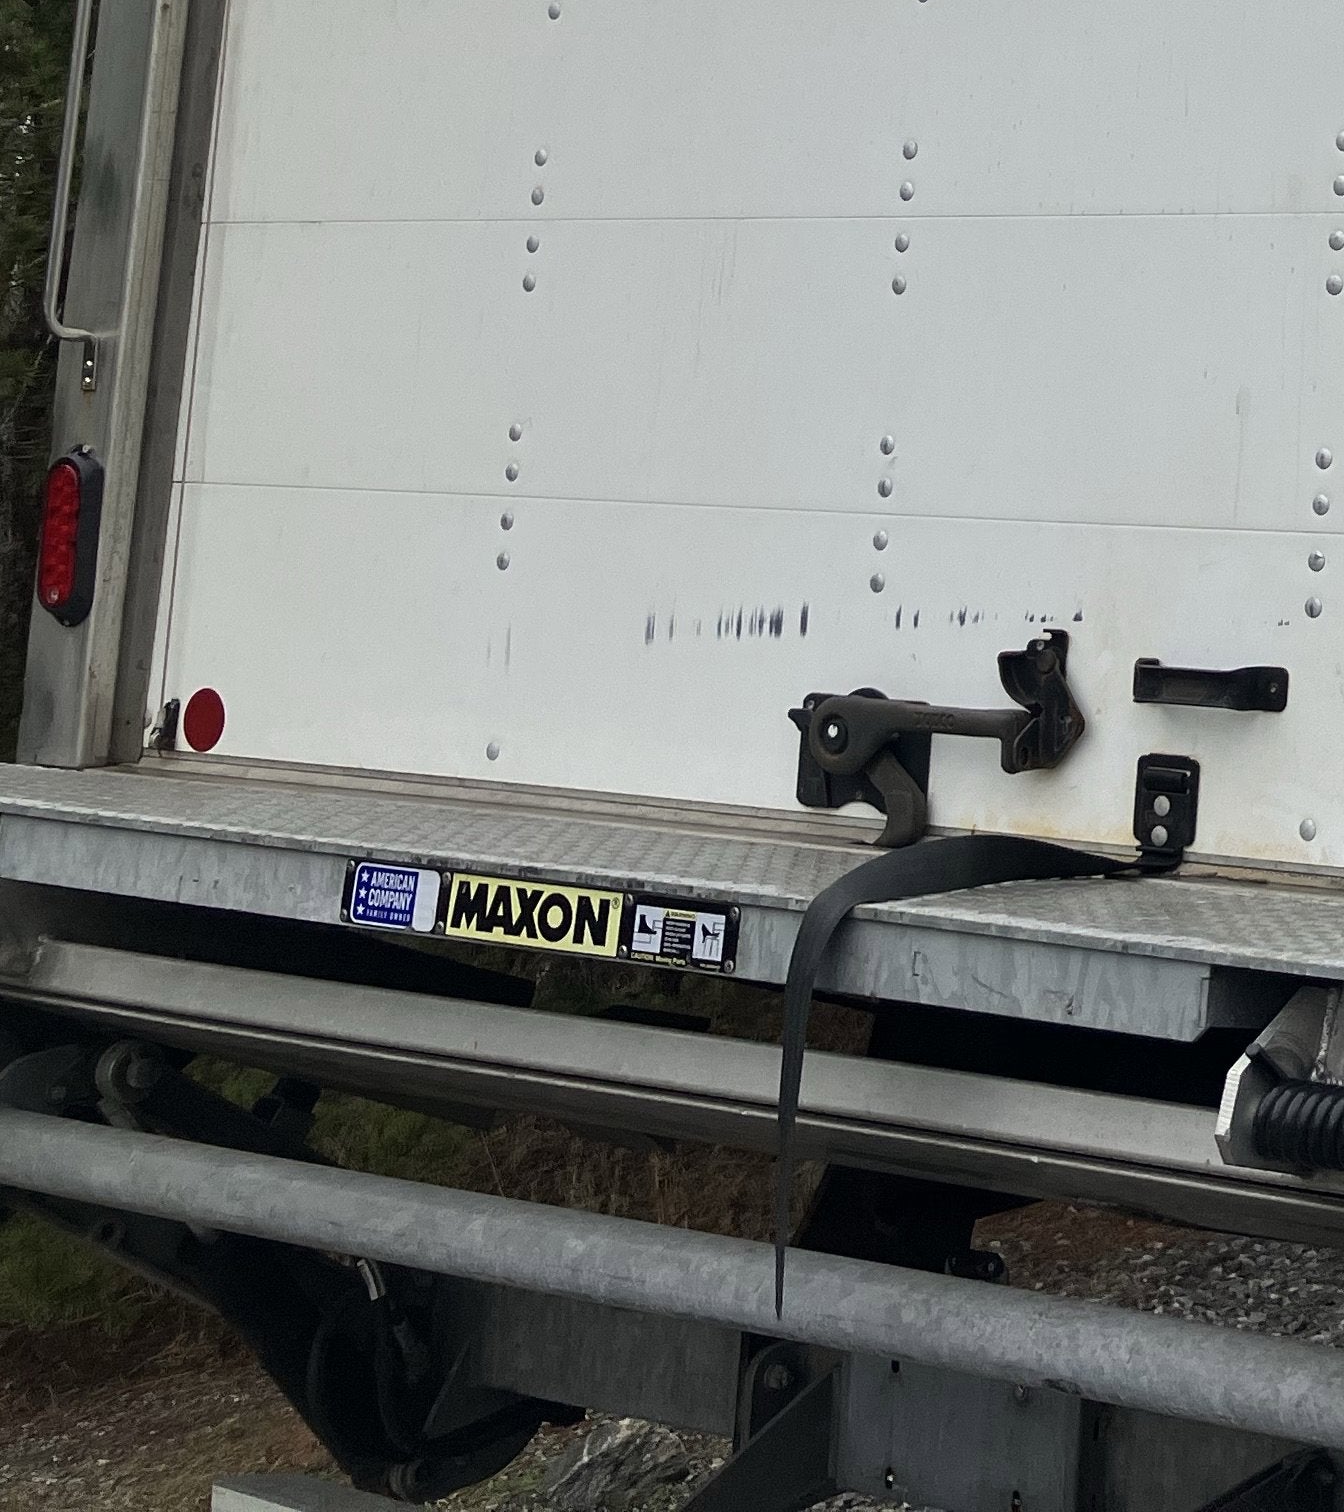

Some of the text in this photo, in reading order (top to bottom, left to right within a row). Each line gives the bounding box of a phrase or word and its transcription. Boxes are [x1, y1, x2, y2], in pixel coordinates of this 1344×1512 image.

[371, 871, 416, 892] AMERICAN
[368, 888, 413, 911] COMPANY
[450, 880, 611, 947] MAXON
